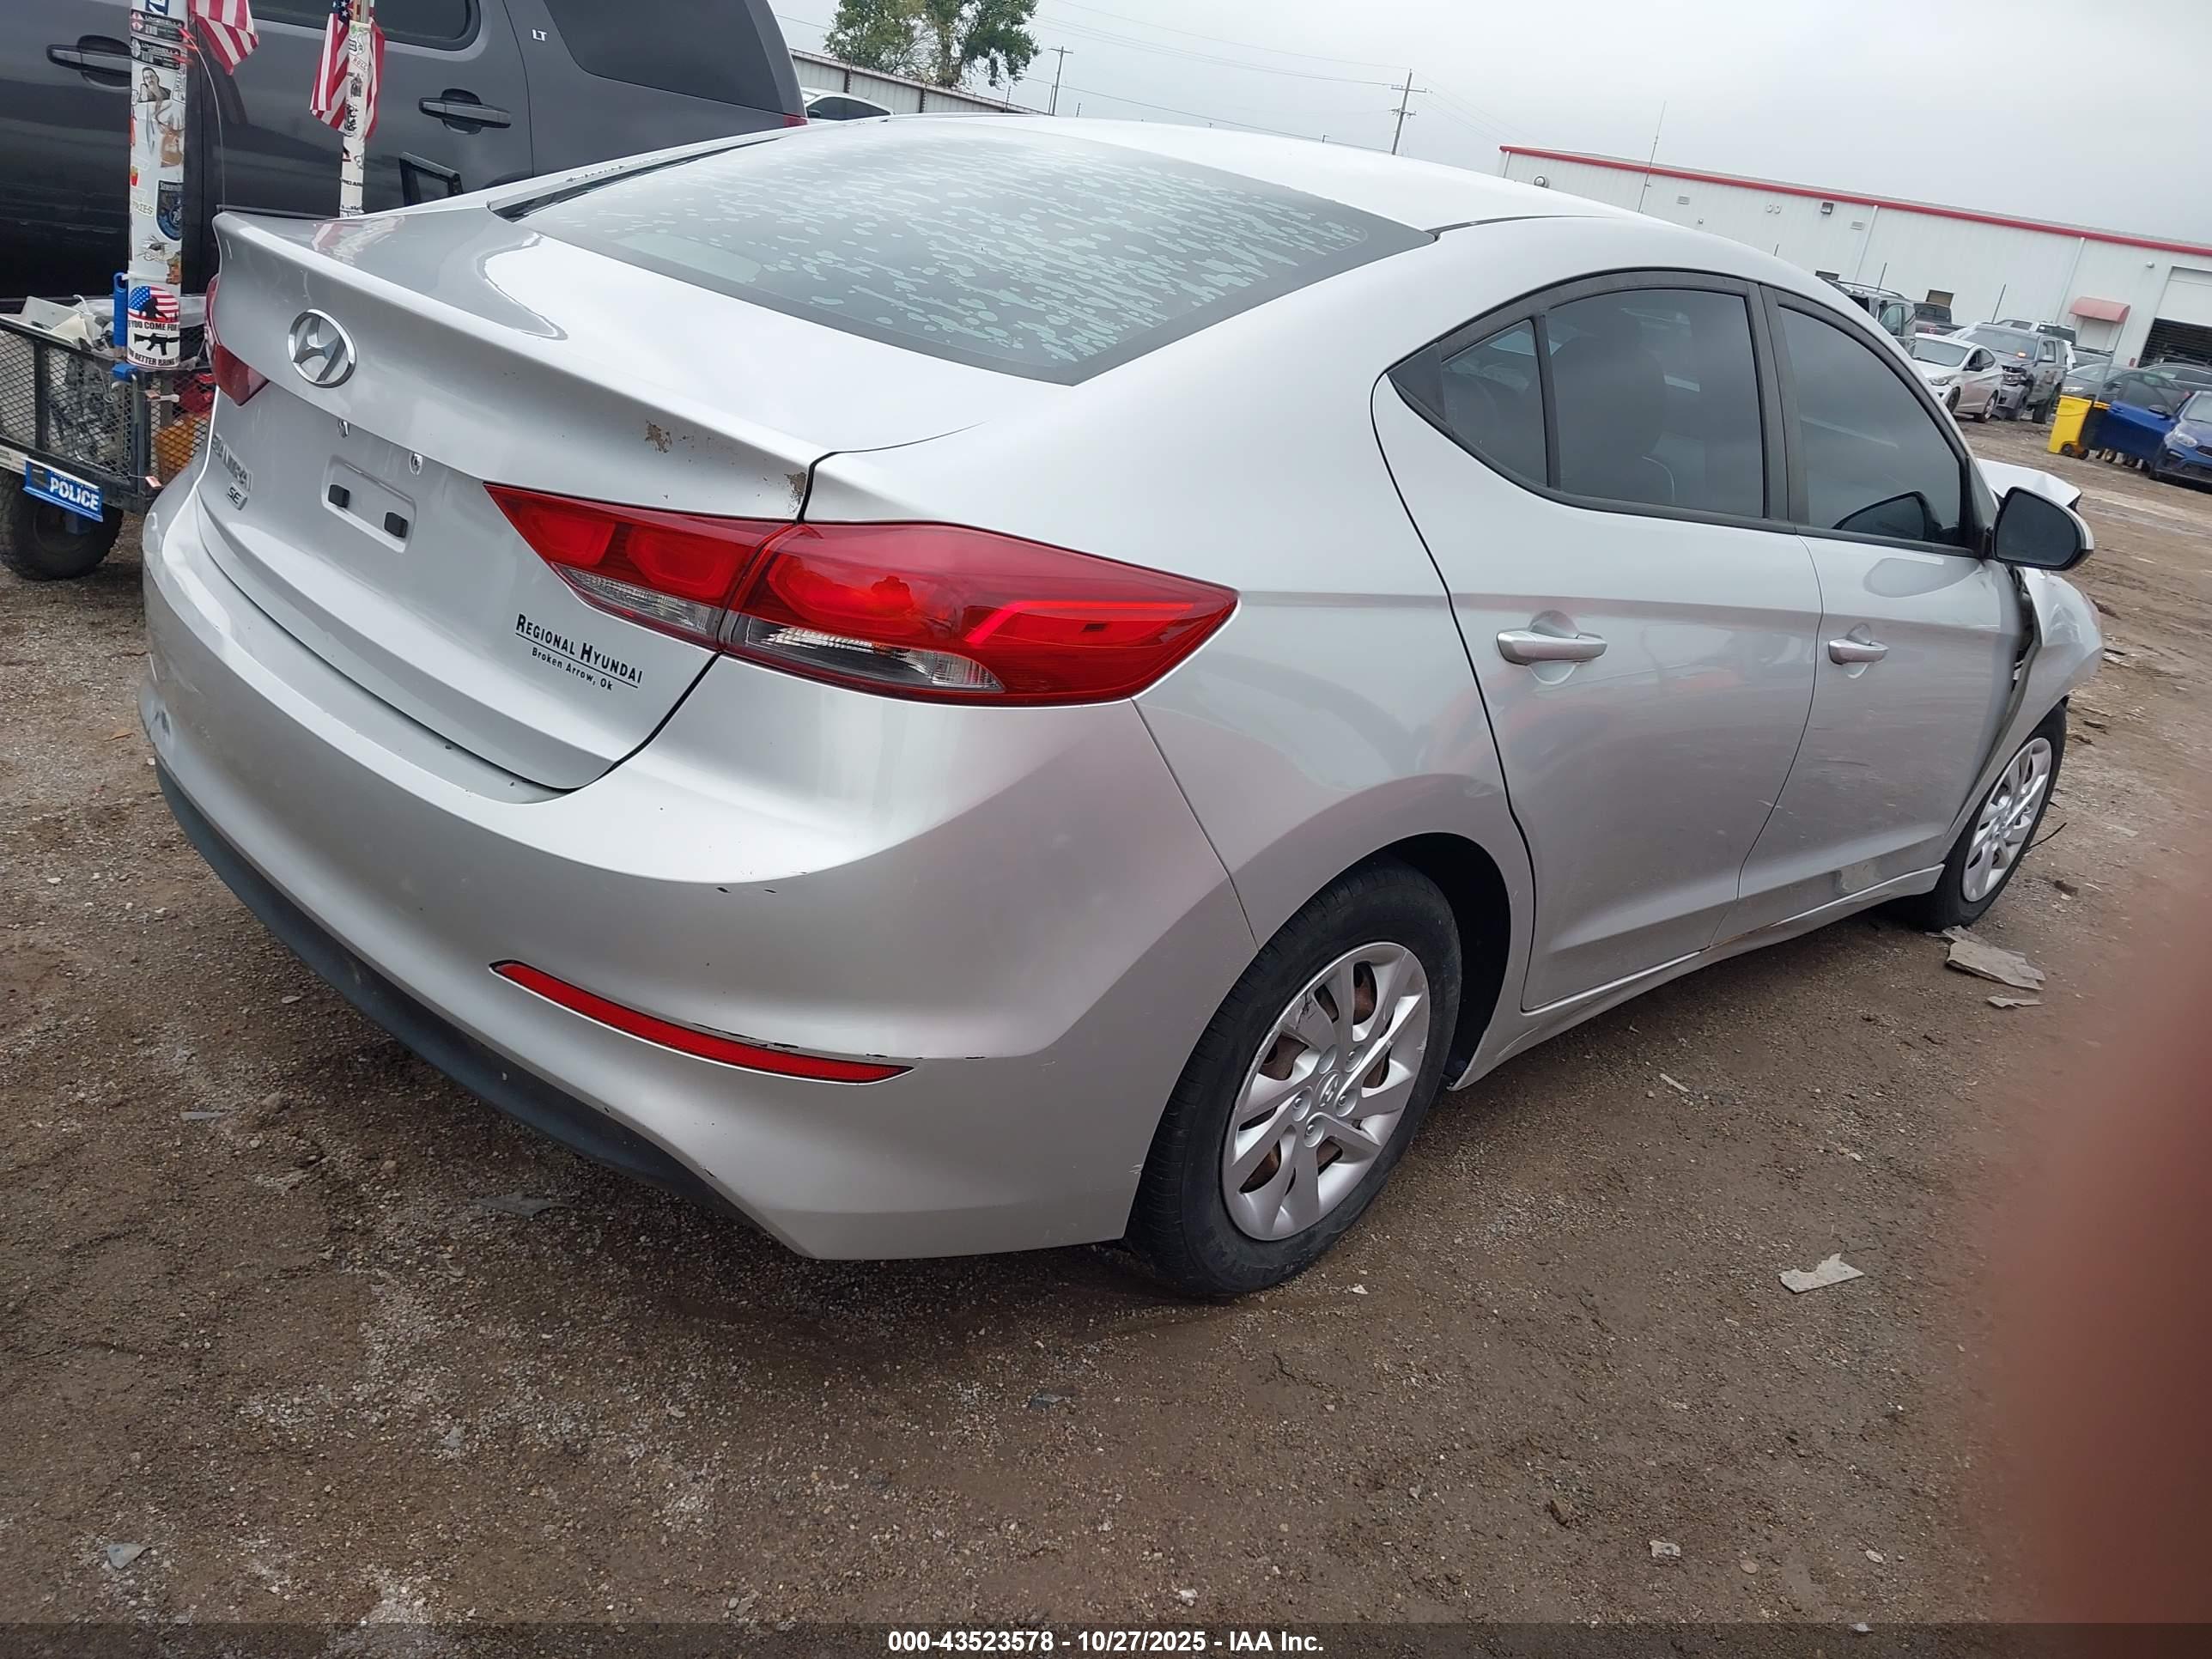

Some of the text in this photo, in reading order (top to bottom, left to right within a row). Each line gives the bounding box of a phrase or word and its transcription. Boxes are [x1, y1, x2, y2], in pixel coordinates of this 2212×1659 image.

[532, 28, 547, 42] LT
[144, 322, 166, 331] COME
[135, 355, 156, 365] BETTER
[49, 476, 100, 512] POLICE
[226, 486, 242, 505] SE
[532, 647, 614, 691] Broken Arrow, Ok
